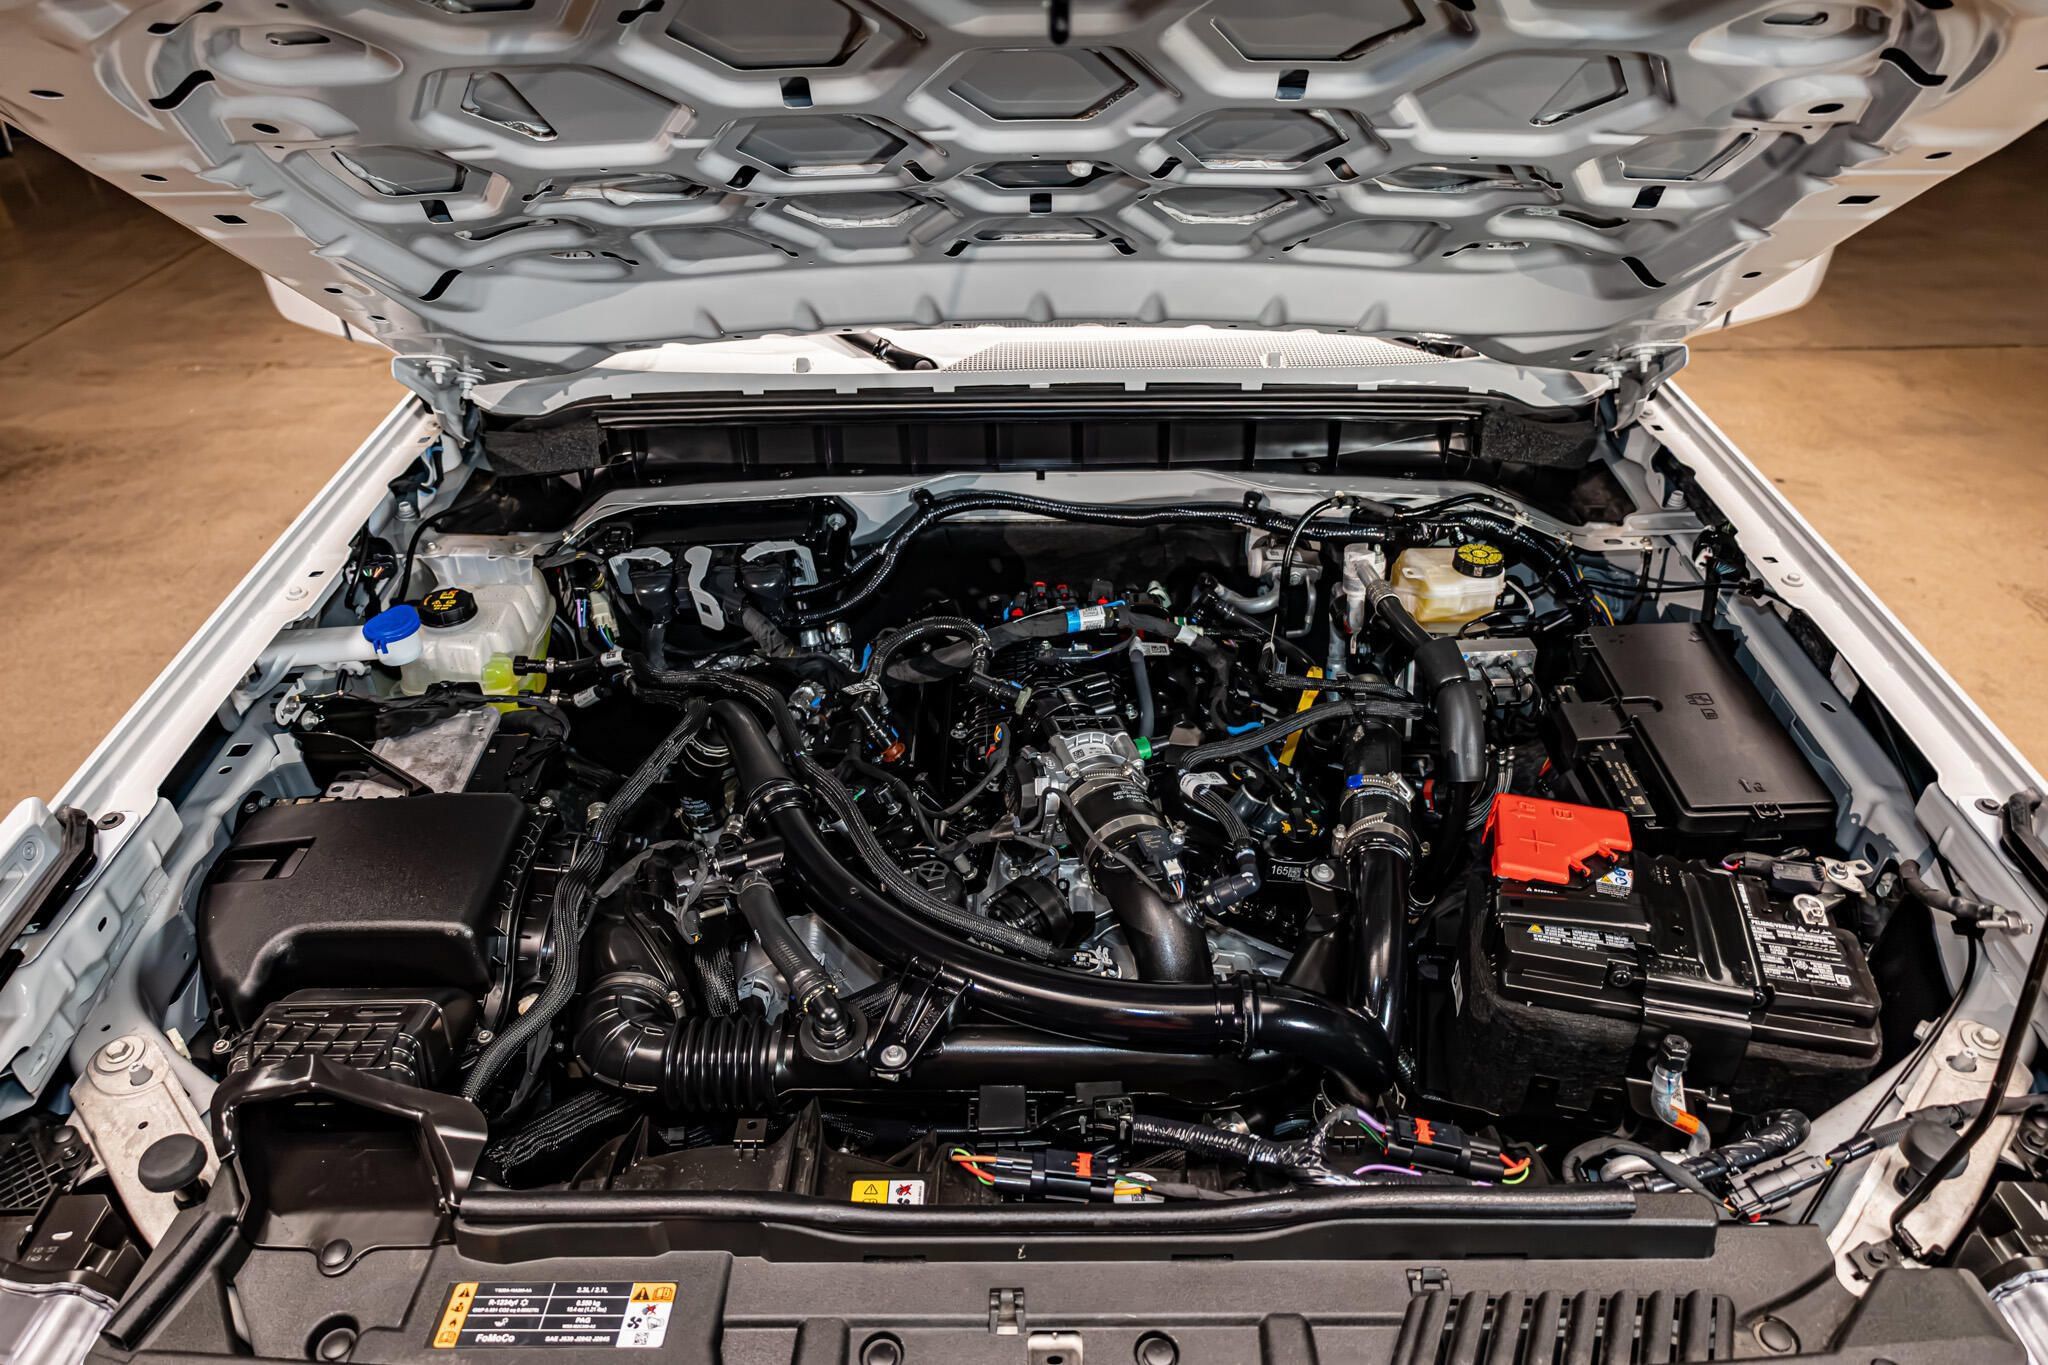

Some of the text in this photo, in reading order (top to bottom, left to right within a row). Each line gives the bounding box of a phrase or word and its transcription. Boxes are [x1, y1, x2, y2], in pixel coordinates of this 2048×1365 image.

[1272, 864, 1289, 876] 165
[488, 1299, 519, 1307] R-1234yf
[475, 1333, 515, 1342] FoMoCo
